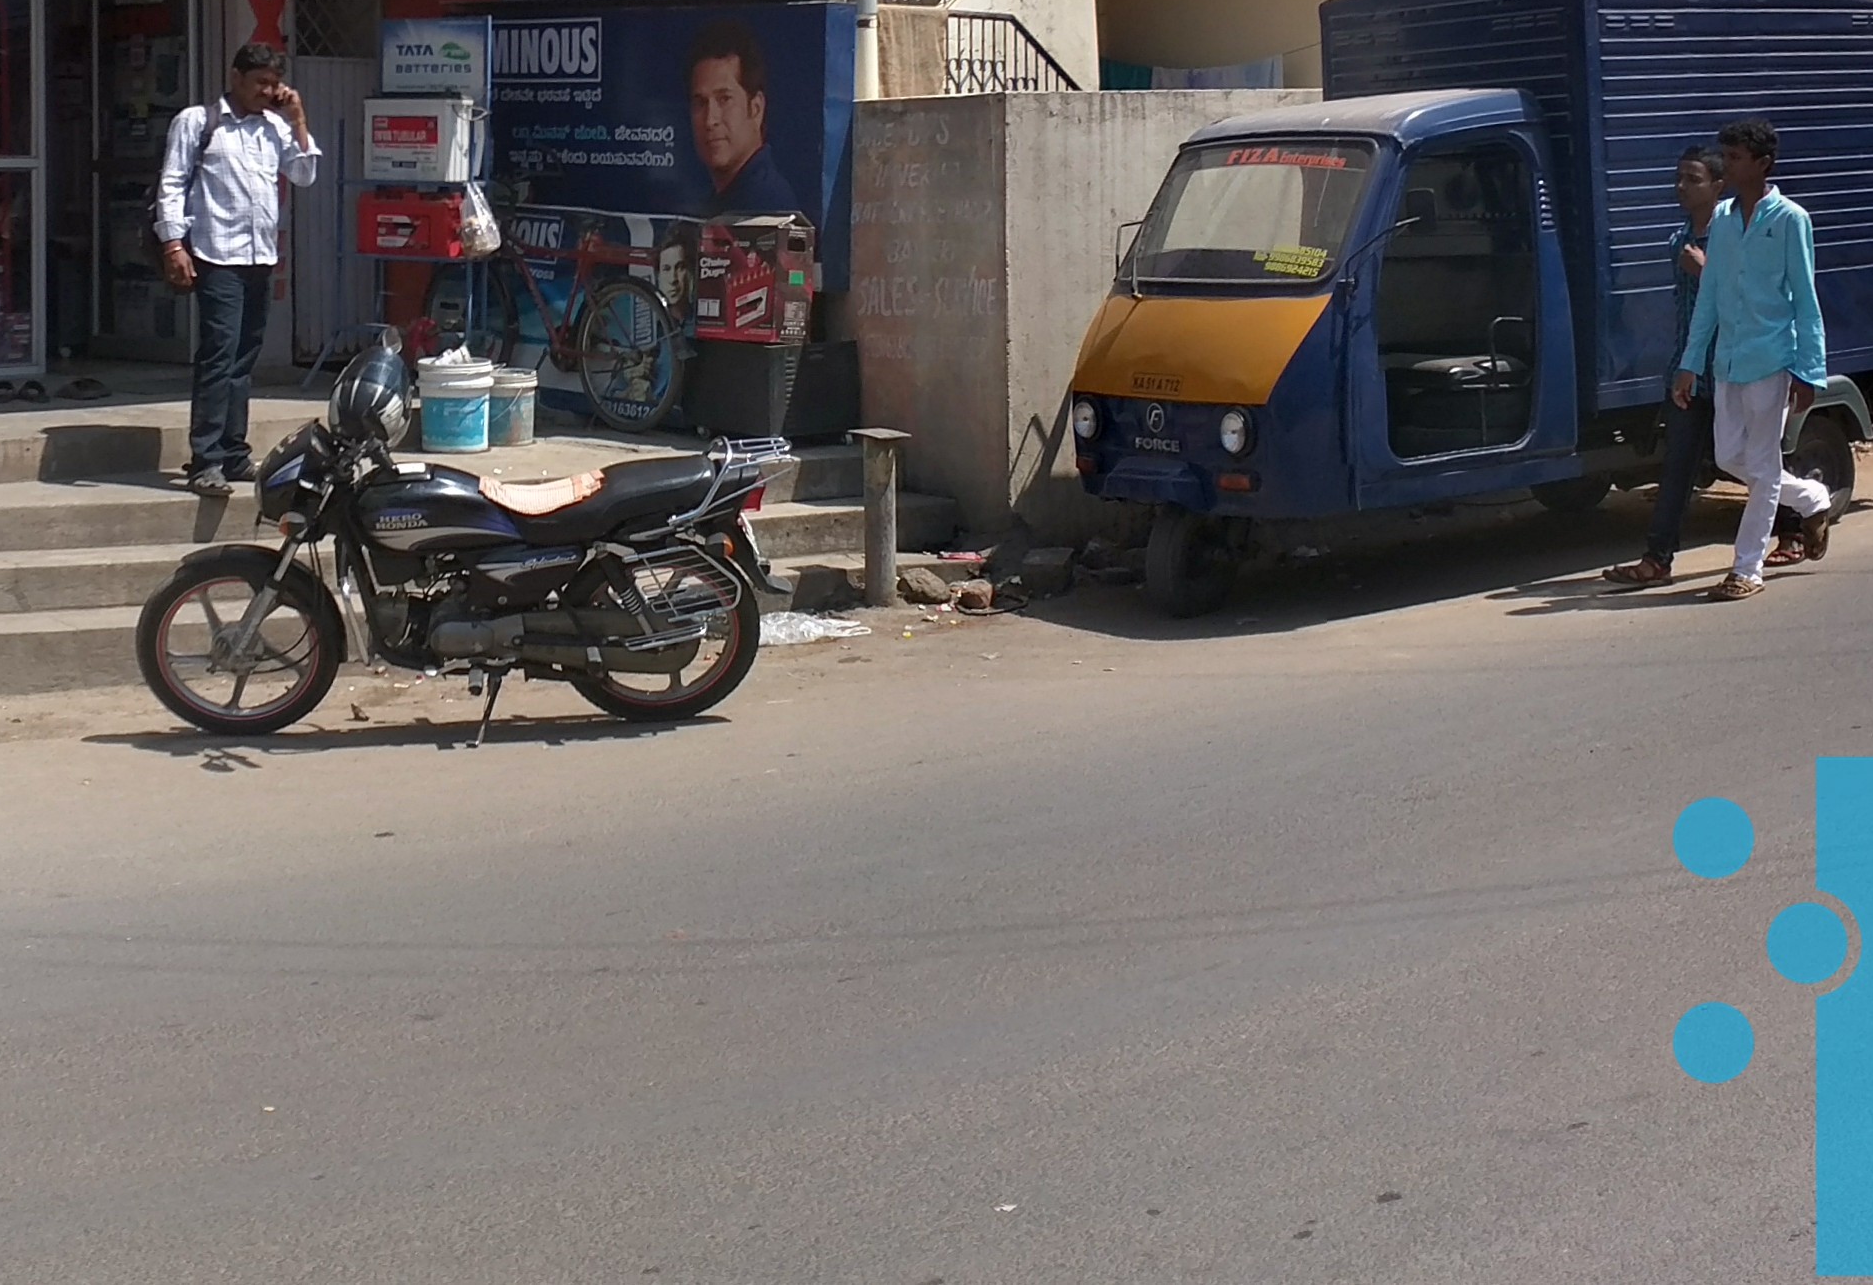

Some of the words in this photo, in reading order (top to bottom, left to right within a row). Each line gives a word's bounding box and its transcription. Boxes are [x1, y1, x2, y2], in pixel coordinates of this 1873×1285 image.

[395, 44, 434, 57] TATA
[1225, 147, 1279, 166] FIZA
[1280, 152, 1347, 170] Enterprises
[1135, 435, 1180, 452] FORCE
[379, 512, 422, 523] HERO
[375, 519, 428, 530] HONDA
